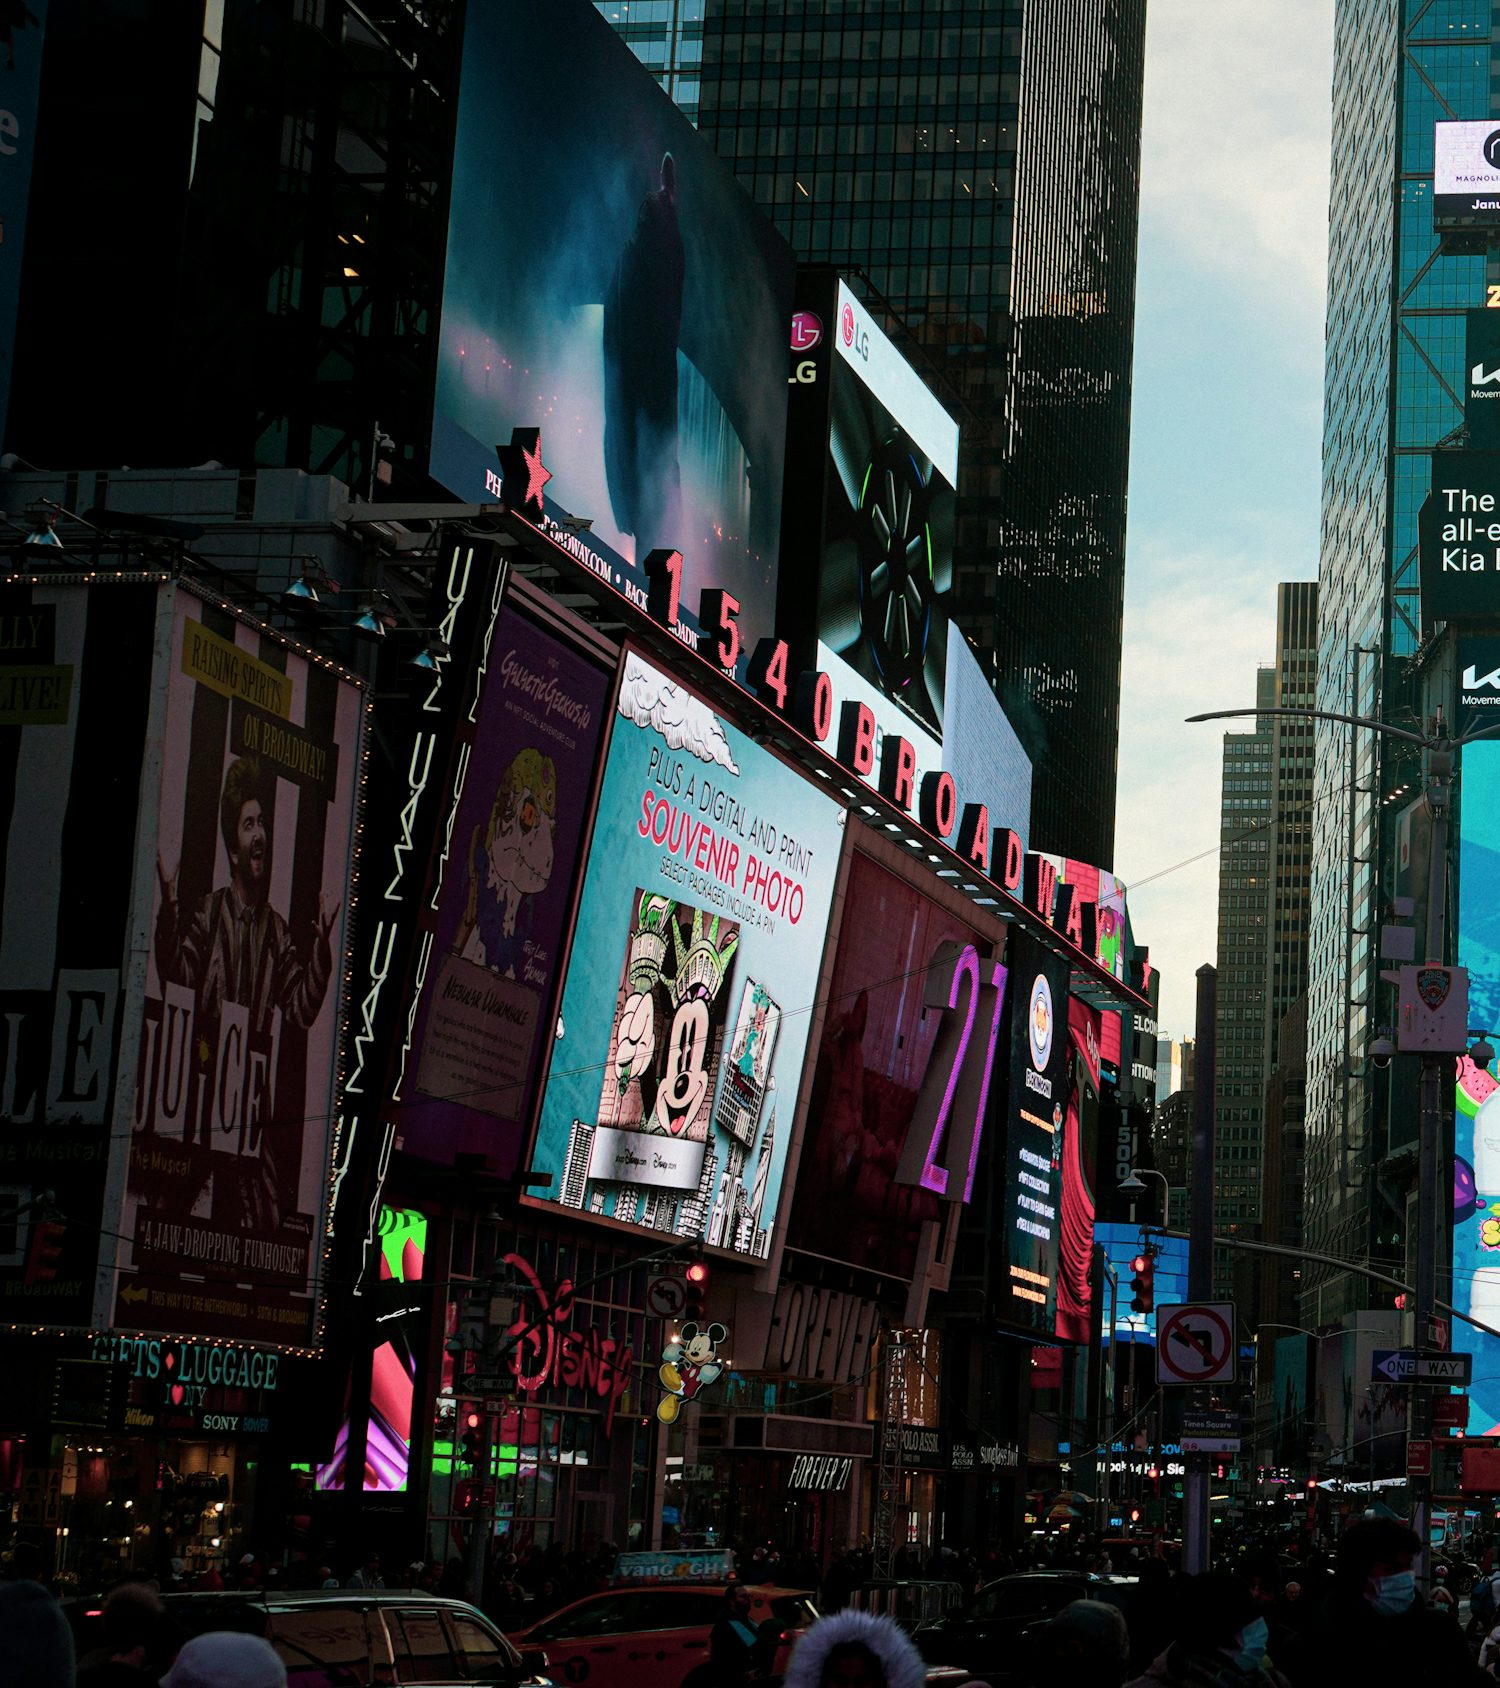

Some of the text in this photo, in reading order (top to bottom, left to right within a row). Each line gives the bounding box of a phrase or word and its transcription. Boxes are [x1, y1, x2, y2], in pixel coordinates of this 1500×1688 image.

[855, 323, 869, 362] LG
[788, 361, 817, 384] G
[1442, 489, 1495, 512] The
[1442, 548, 1485, 571] Kia
[624, 578, 649, 612] BACK
[660, 550, 833, 742] 1540
[190, 633, 283, 714] RAISING SPIRITS
[243, 713, 327, 783] ON BROADWAY!
[648, 746, 813, 878] PLUS A DIGITAL AND PRINT
[637, 789, 804, 926] SOUVENIR PHOTO
[660, 856, 689, 886] SELECT
[688, 871, 725, 908] PACKAGES
[725, 894, 757, 928] INCLUDE
[134, 985, 269, 1159] JUICE
[918, 943, 1009, 1206] 21
[1115, 1108, 1131, 1180] 1500
[151, 1151, 192, 1177] Musical
[153, 1221, 240, 1265] JAW-DROPPING
[150, 1289, 167, 1308] THIS
[166, 1291, 182, 1310] WAY
[182, 1294, 192, 1310] TO
[203, 1296, 248, 1318] NETHERWORLD
[501, 1252, 634, 1441] Disney
[763, 1282, 881, 1386] FOREVER
[177, 1343, 279, 1391] LUGGAGE
[467, 1379, 511, 1389] ONE WAY
[1386, 1359, 1458, 1375] ONE WAY
[184, 1385, 207, 1407] NY
[124, 1407, 155, 1427] Nikon
[202, 1414, 239, 1431] SONY
[1183, 1420, 1232, 1430] Times Square
[900, 1431, 918, 1451] POLO
[952, 1451, 974, 1459] POLO
[787, 1454, 853, 1491] FOREVER 21
[952, 1458, 976, 1466] ASSN.
